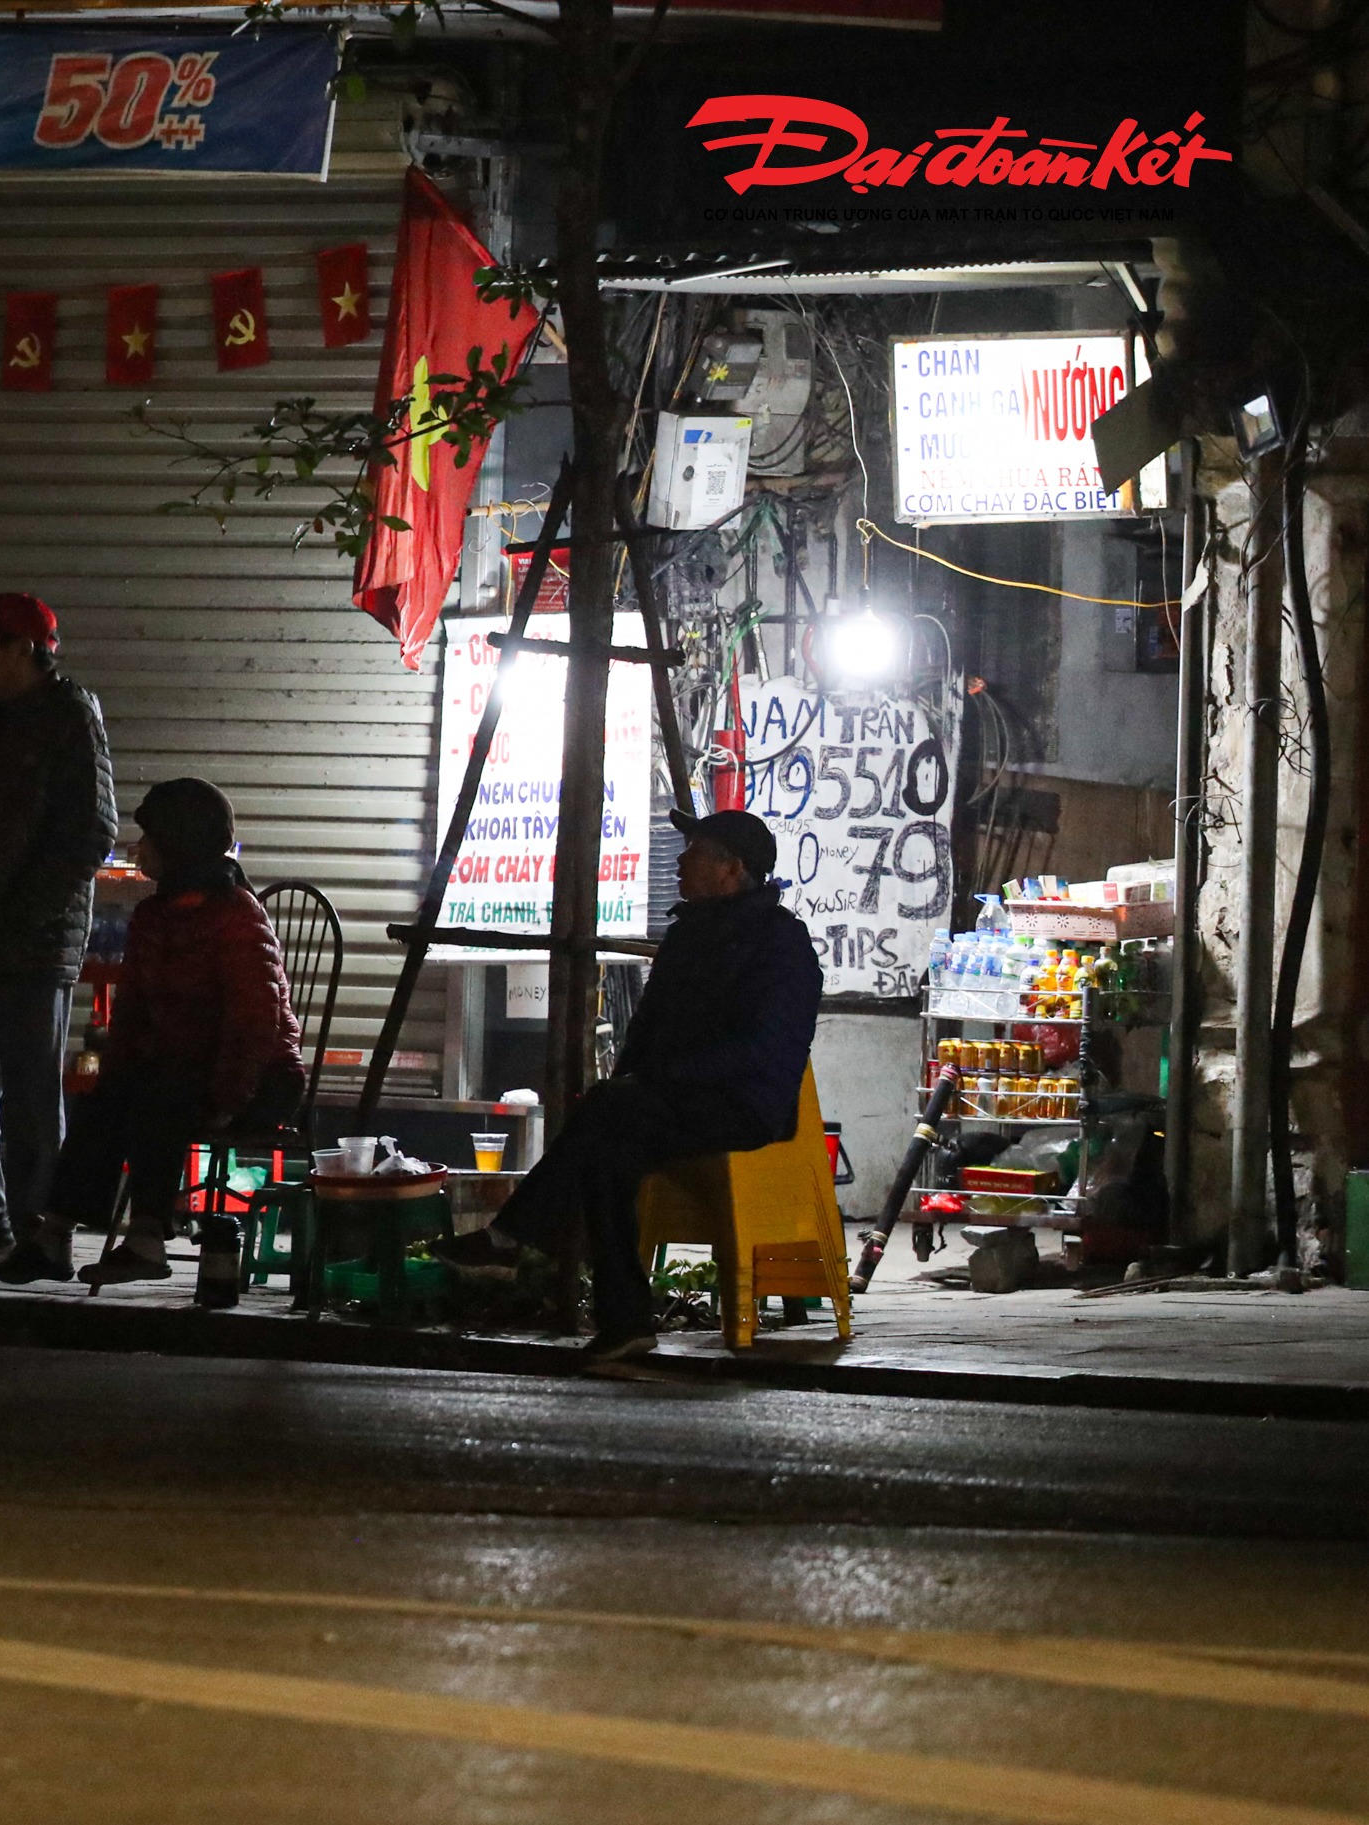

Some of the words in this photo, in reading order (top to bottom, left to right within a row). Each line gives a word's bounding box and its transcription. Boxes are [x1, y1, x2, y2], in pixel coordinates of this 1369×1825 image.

[479, 781, 514, 804] NEM
[518, 780, 564, 803] CHU
[464, 816, 518, 840] KHOAI
[522, 810, 560, 840] TÂY
[494, 847, 545, 883] CHÁY
[847, 820, 951, 920] 79
